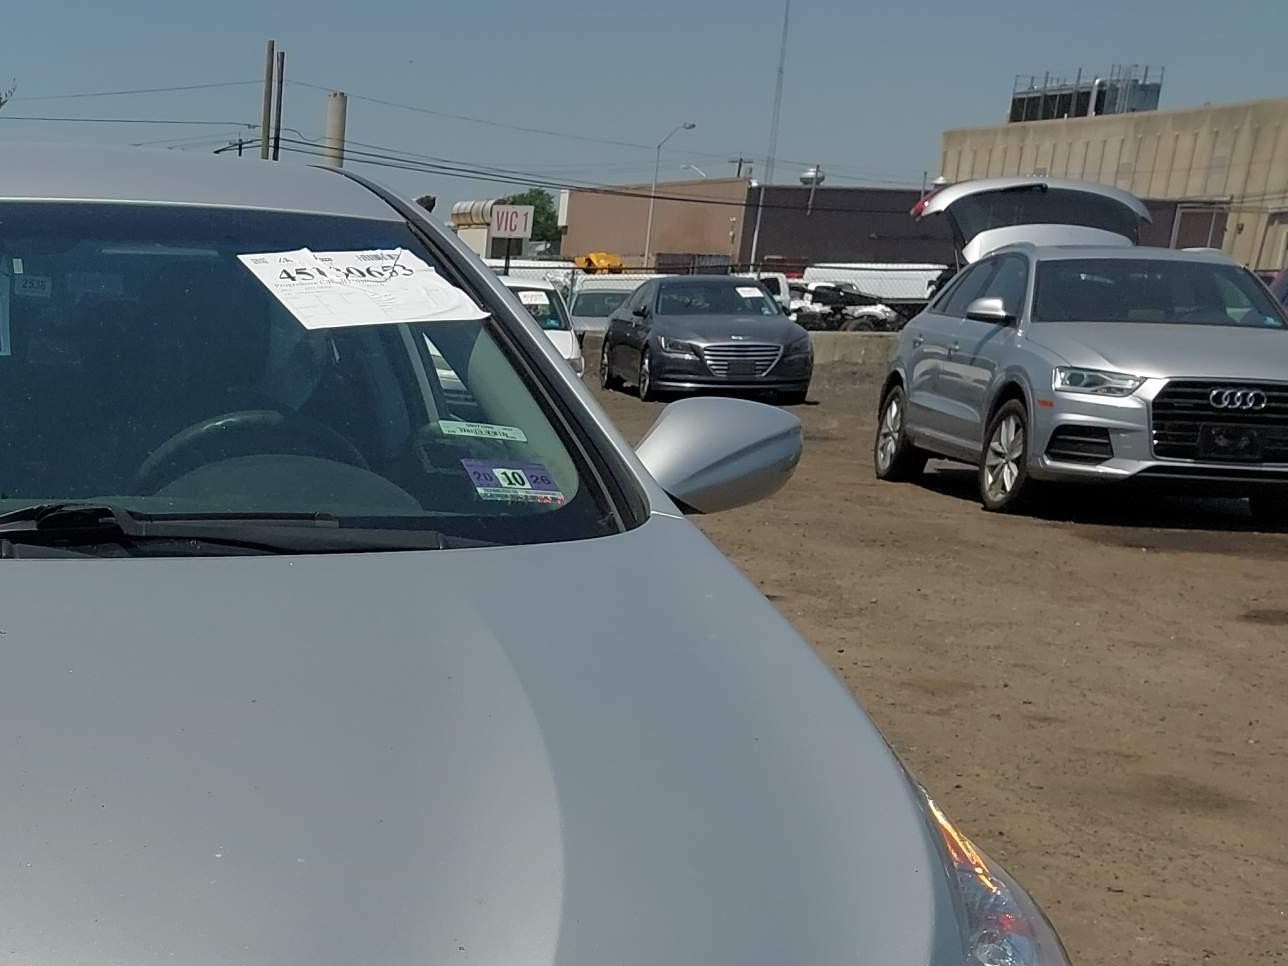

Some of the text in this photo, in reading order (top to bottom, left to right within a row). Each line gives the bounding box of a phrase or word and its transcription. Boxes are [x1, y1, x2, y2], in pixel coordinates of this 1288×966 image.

[496, 210, 529, 233] VIC 1
[472, 471, 494, 483] 20
[501, 471, 526, 487] 10
